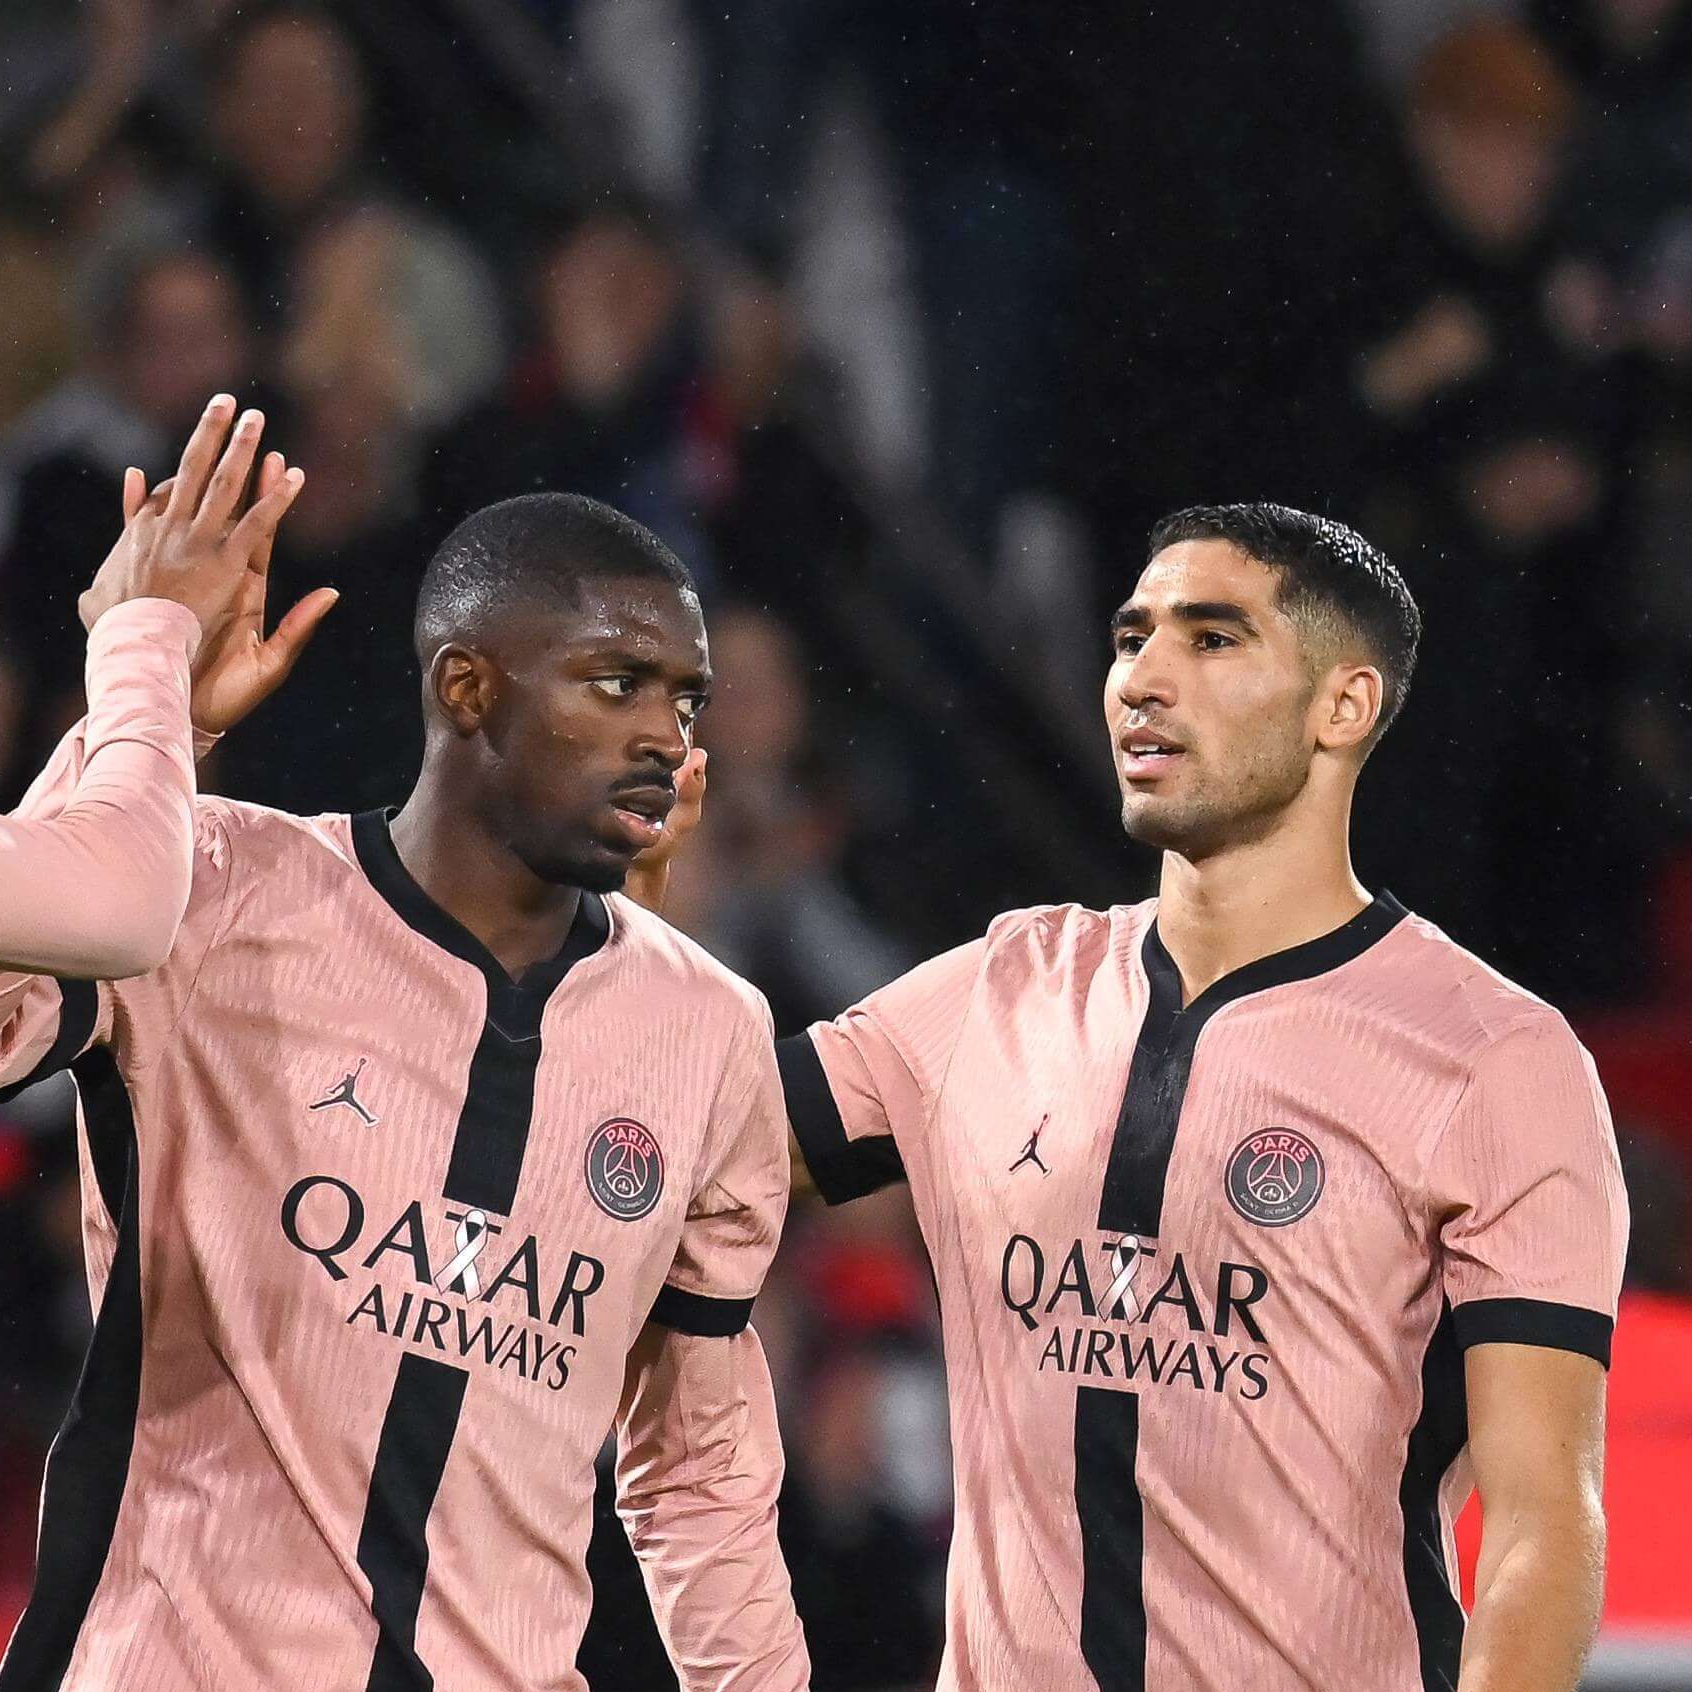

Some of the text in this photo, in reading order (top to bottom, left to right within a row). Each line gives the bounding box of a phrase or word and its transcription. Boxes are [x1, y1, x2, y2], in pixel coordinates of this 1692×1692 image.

[605, 1127, 653, 1158] PARIS
[1250, 1137, 1309, 1162] PARIS
[347, 1285, 577, 1391] AIRWAYS
[1039, 1327, 1269, 1400] AIRWAYS
